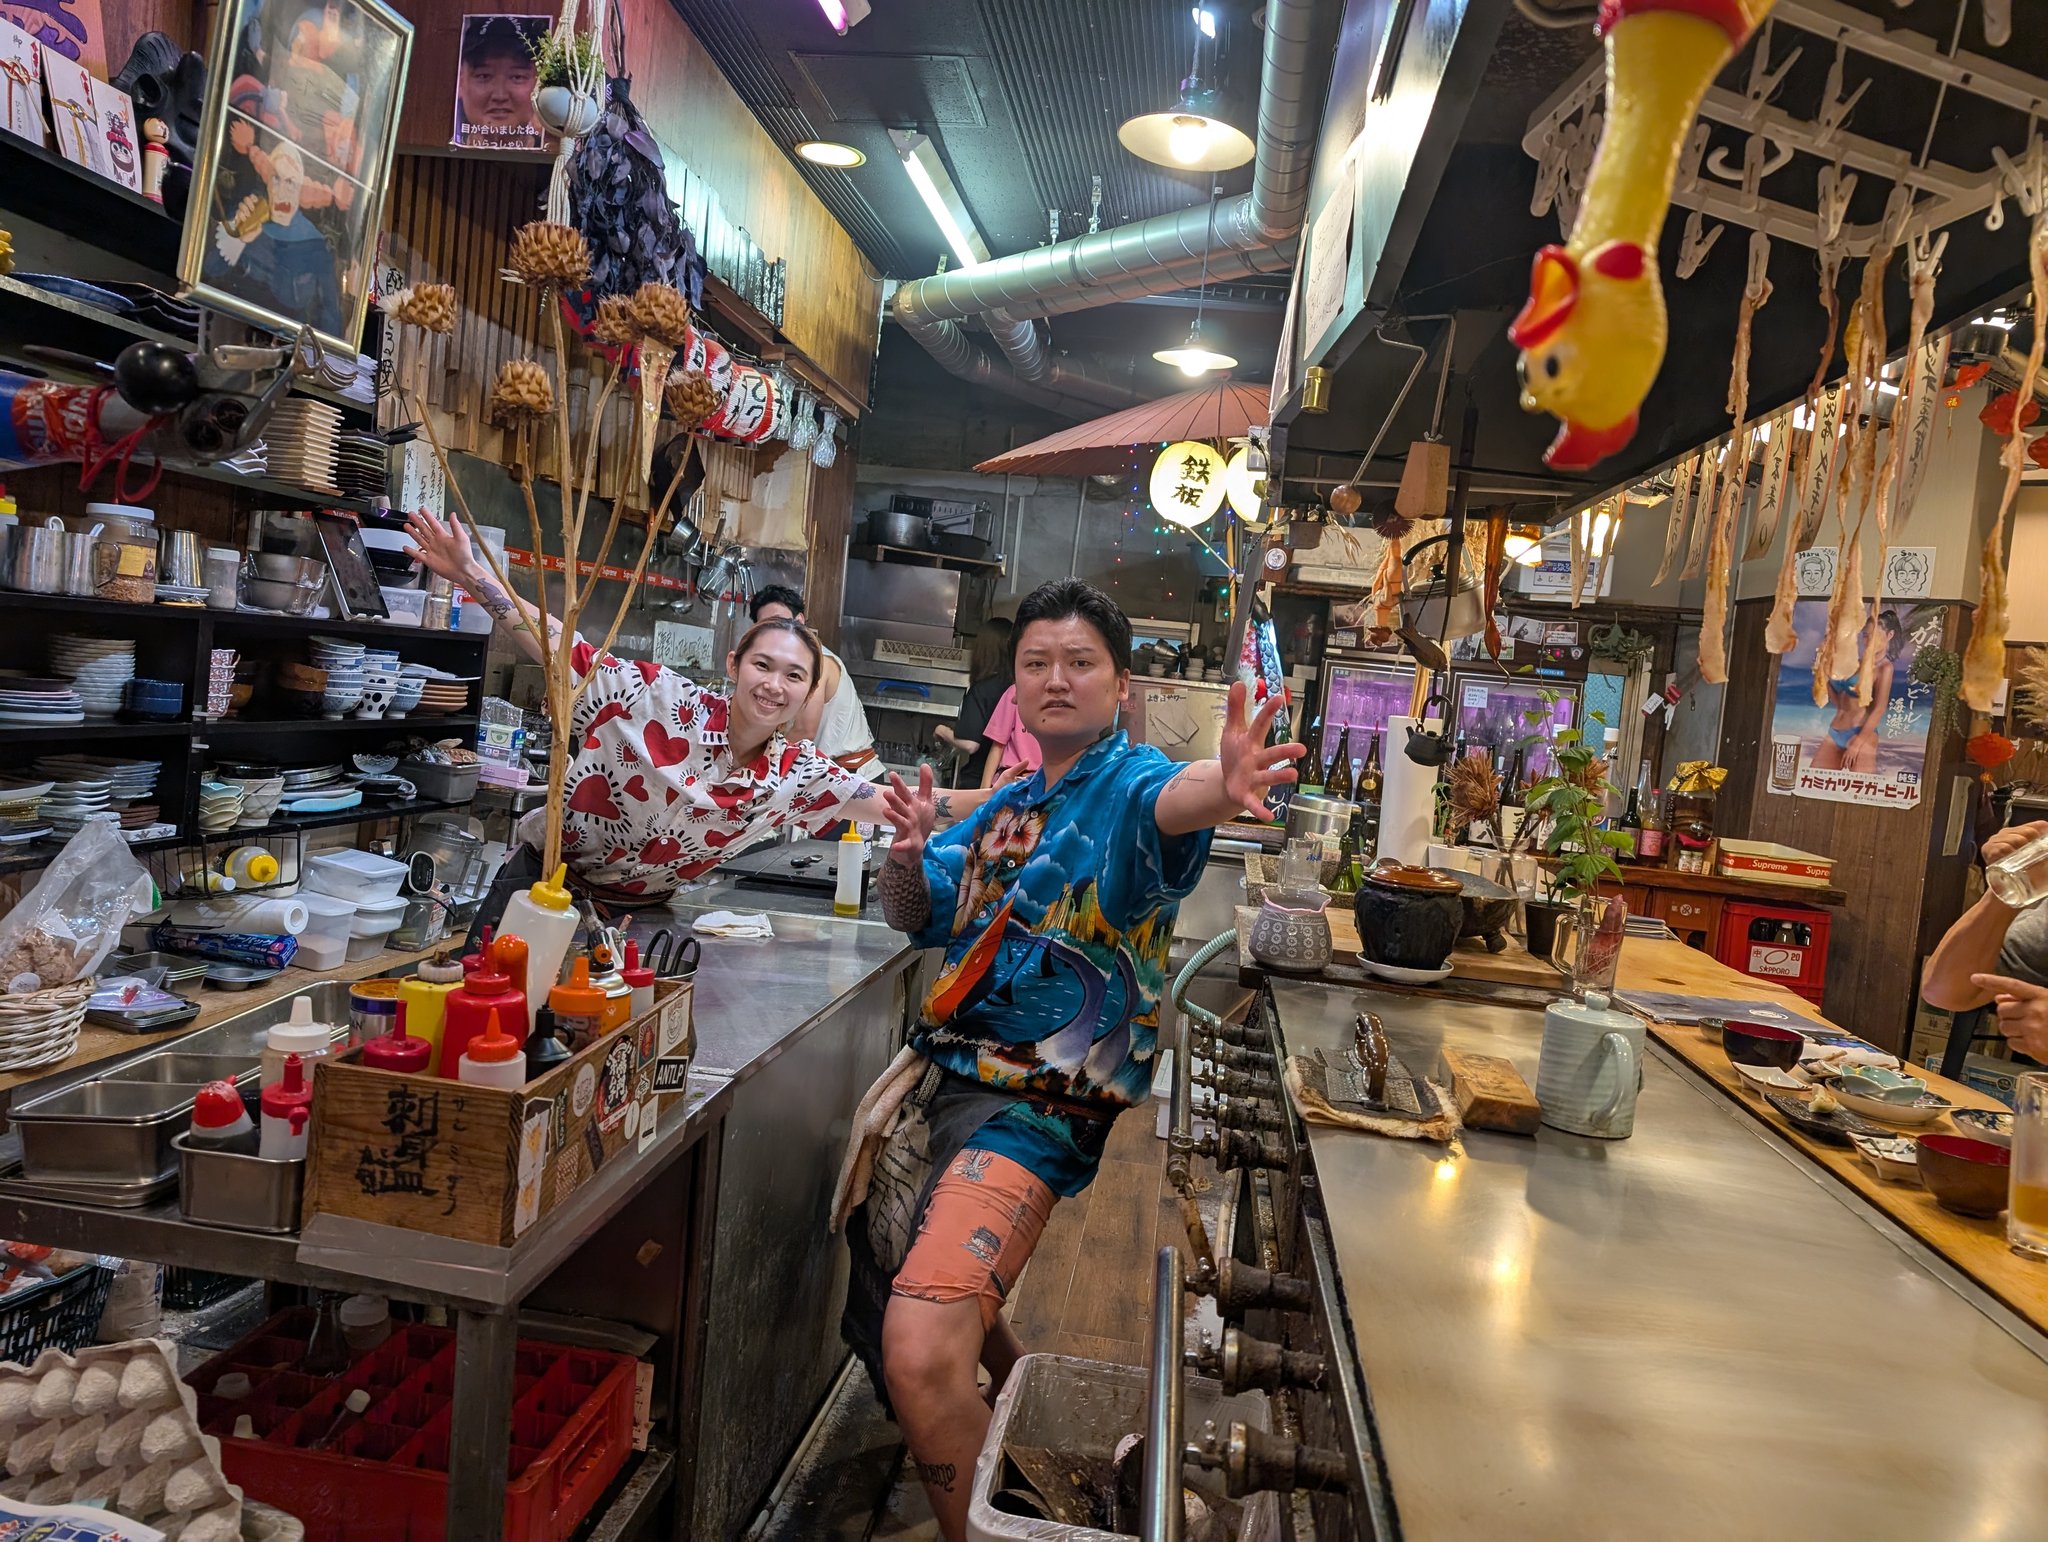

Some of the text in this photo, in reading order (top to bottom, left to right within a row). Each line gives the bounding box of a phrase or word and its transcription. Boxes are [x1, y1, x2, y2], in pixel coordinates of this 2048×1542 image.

[461, 123, 539, 136] 目が合いましたね。
[1171, 455, 1211, 508] 鉄板
[1776, 743, 1797, 754] KAMI
[1776, 754, 1796, 763] KATZ
[1801, 774, 1918, 800] カミカツラガービール
[1752, 859, 1788, 872] Supreme
[1791, 953, 1801, 961] 20
[656, 1063, 684, 1086] ANTLP
